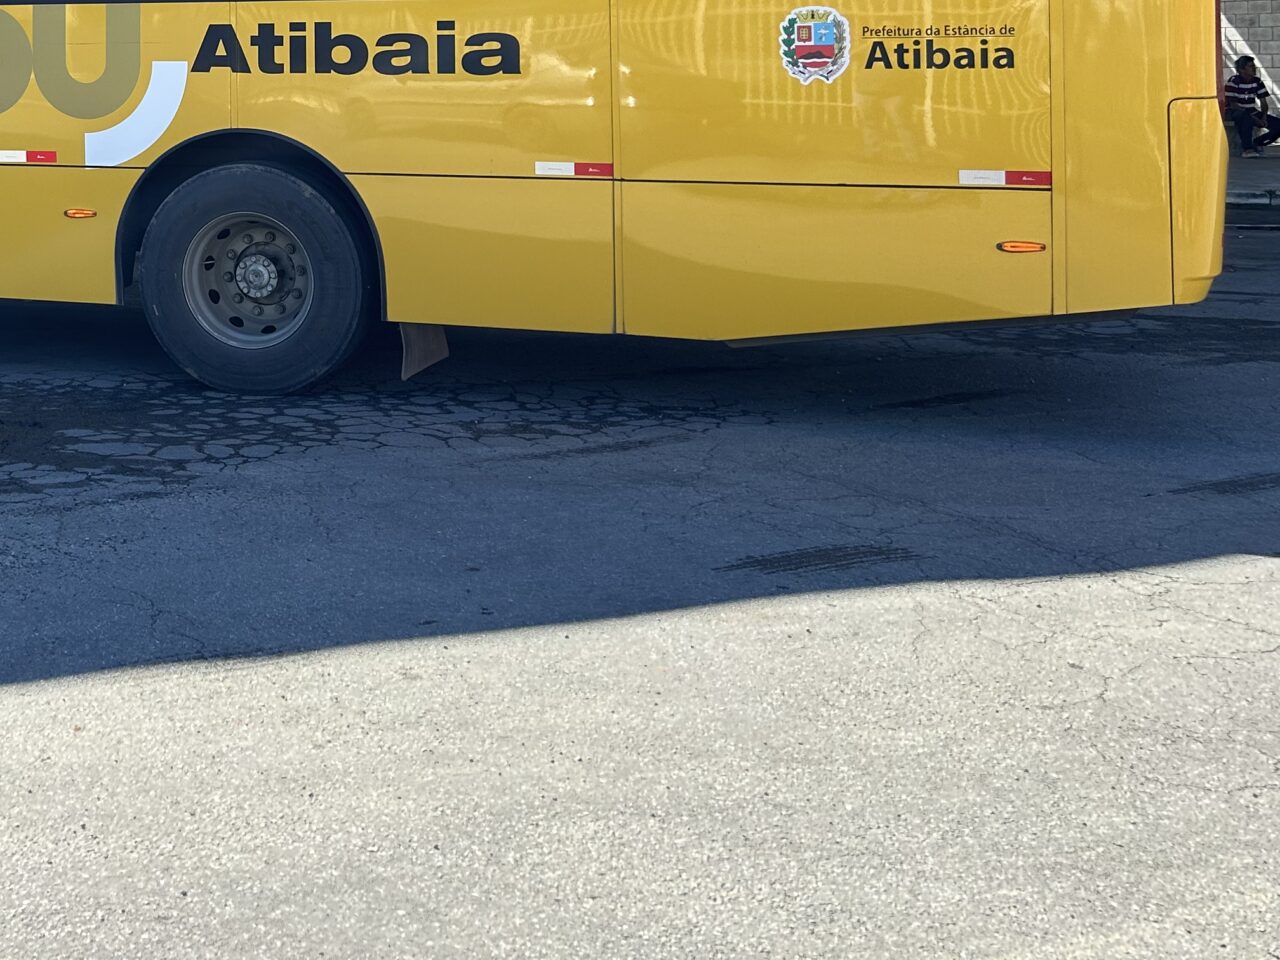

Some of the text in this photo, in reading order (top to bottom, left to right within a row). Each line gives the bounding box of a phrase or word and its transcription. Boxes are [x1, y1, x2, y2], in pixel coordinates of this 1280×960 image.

[862, 24, 1015, 37] Prefeitura da Estância de
[190, 20, 522, 76] Atibaia
[864, 39, 1016, 70] Atibaia
